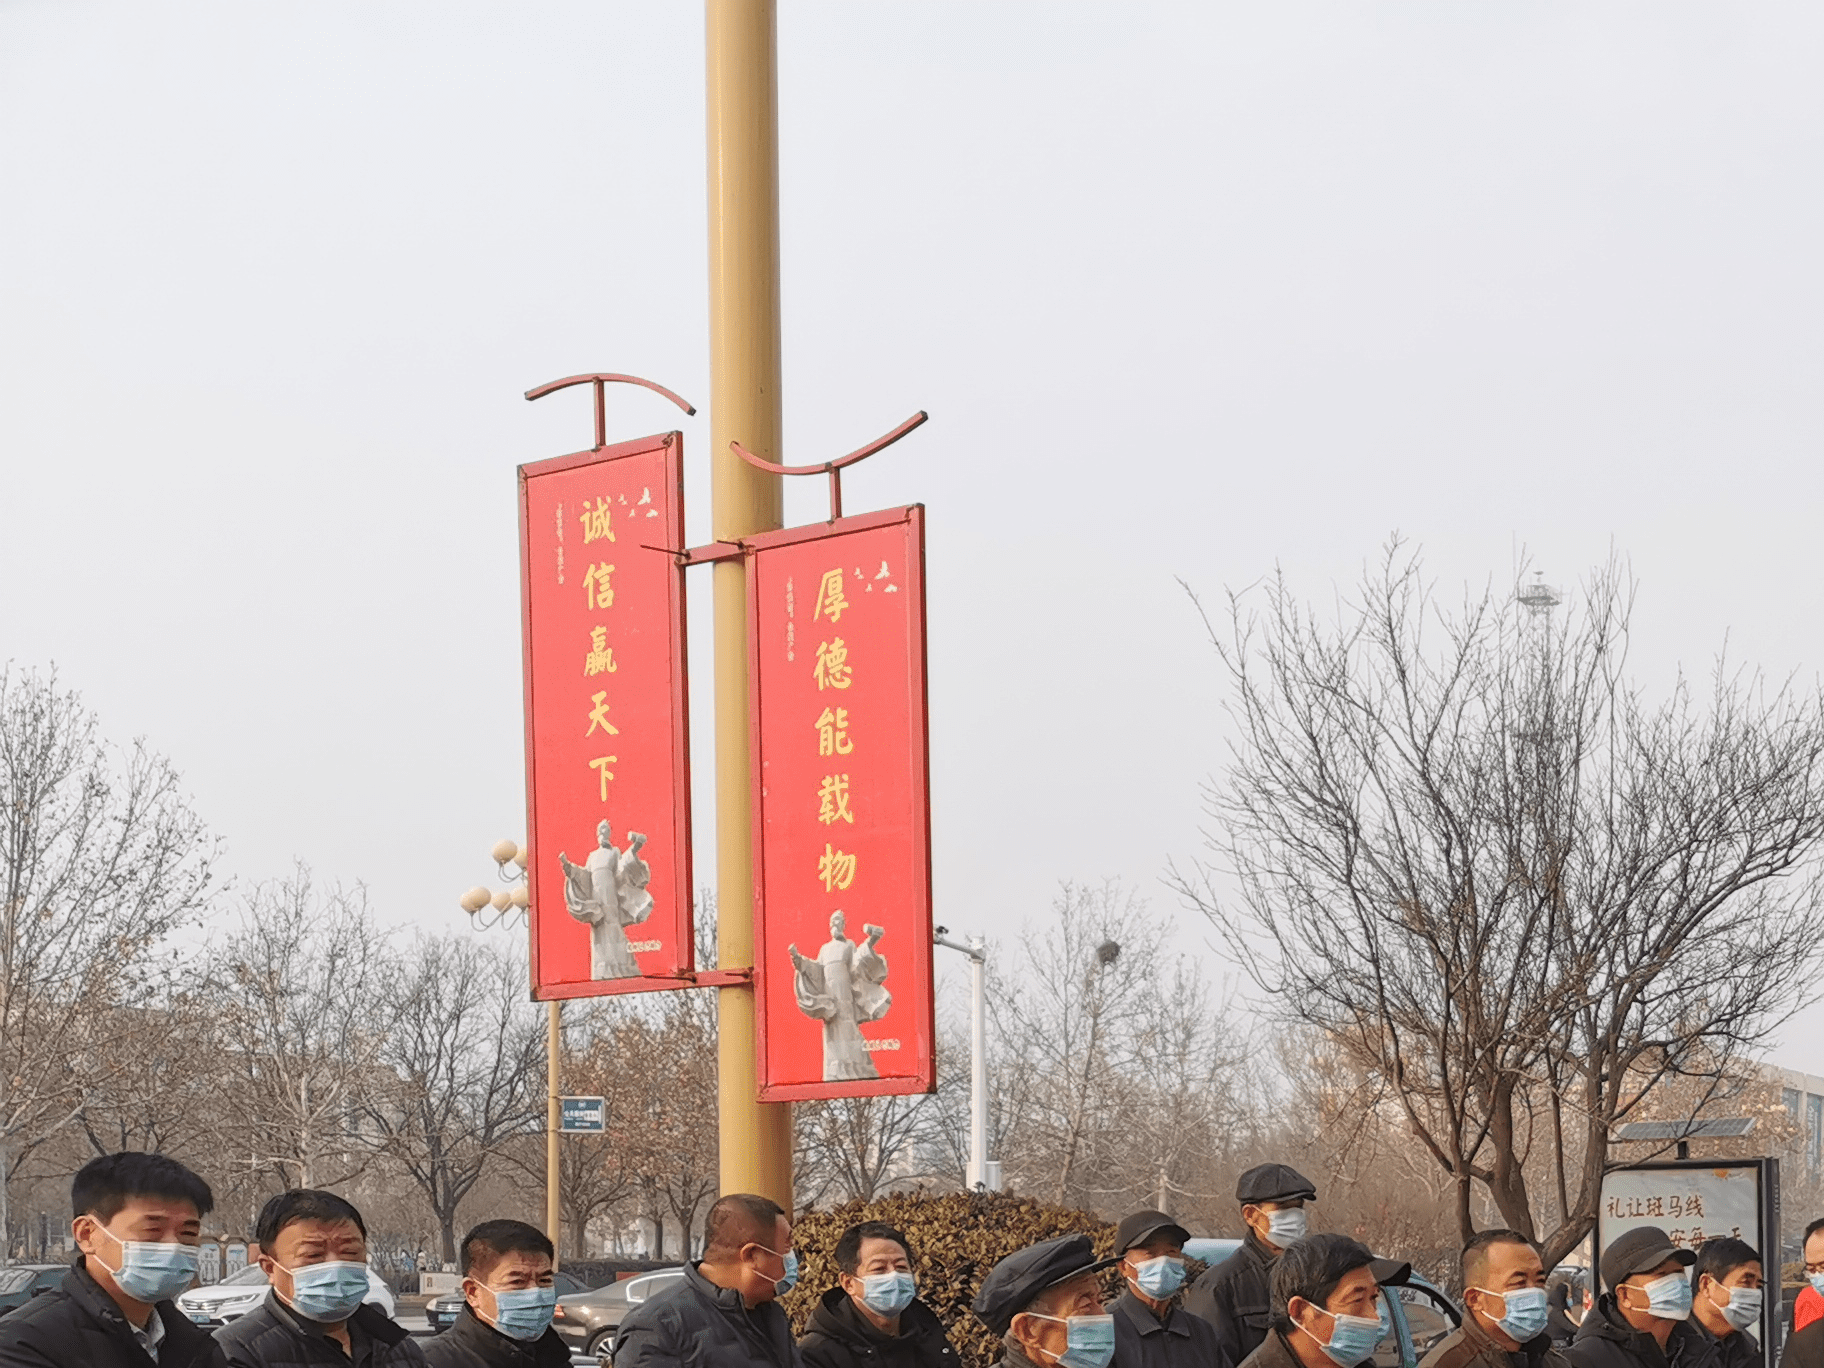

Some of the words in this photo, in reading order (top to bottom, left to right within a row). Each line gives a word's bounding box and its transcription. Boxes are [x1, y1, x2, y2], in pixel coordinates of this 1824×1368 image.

[580, 495, 619, 802] 诚信赢天下
[813, 566, 857, 893] 厚德能载物
[1606, 1195, 1705, 1219] 礼让斑马线
